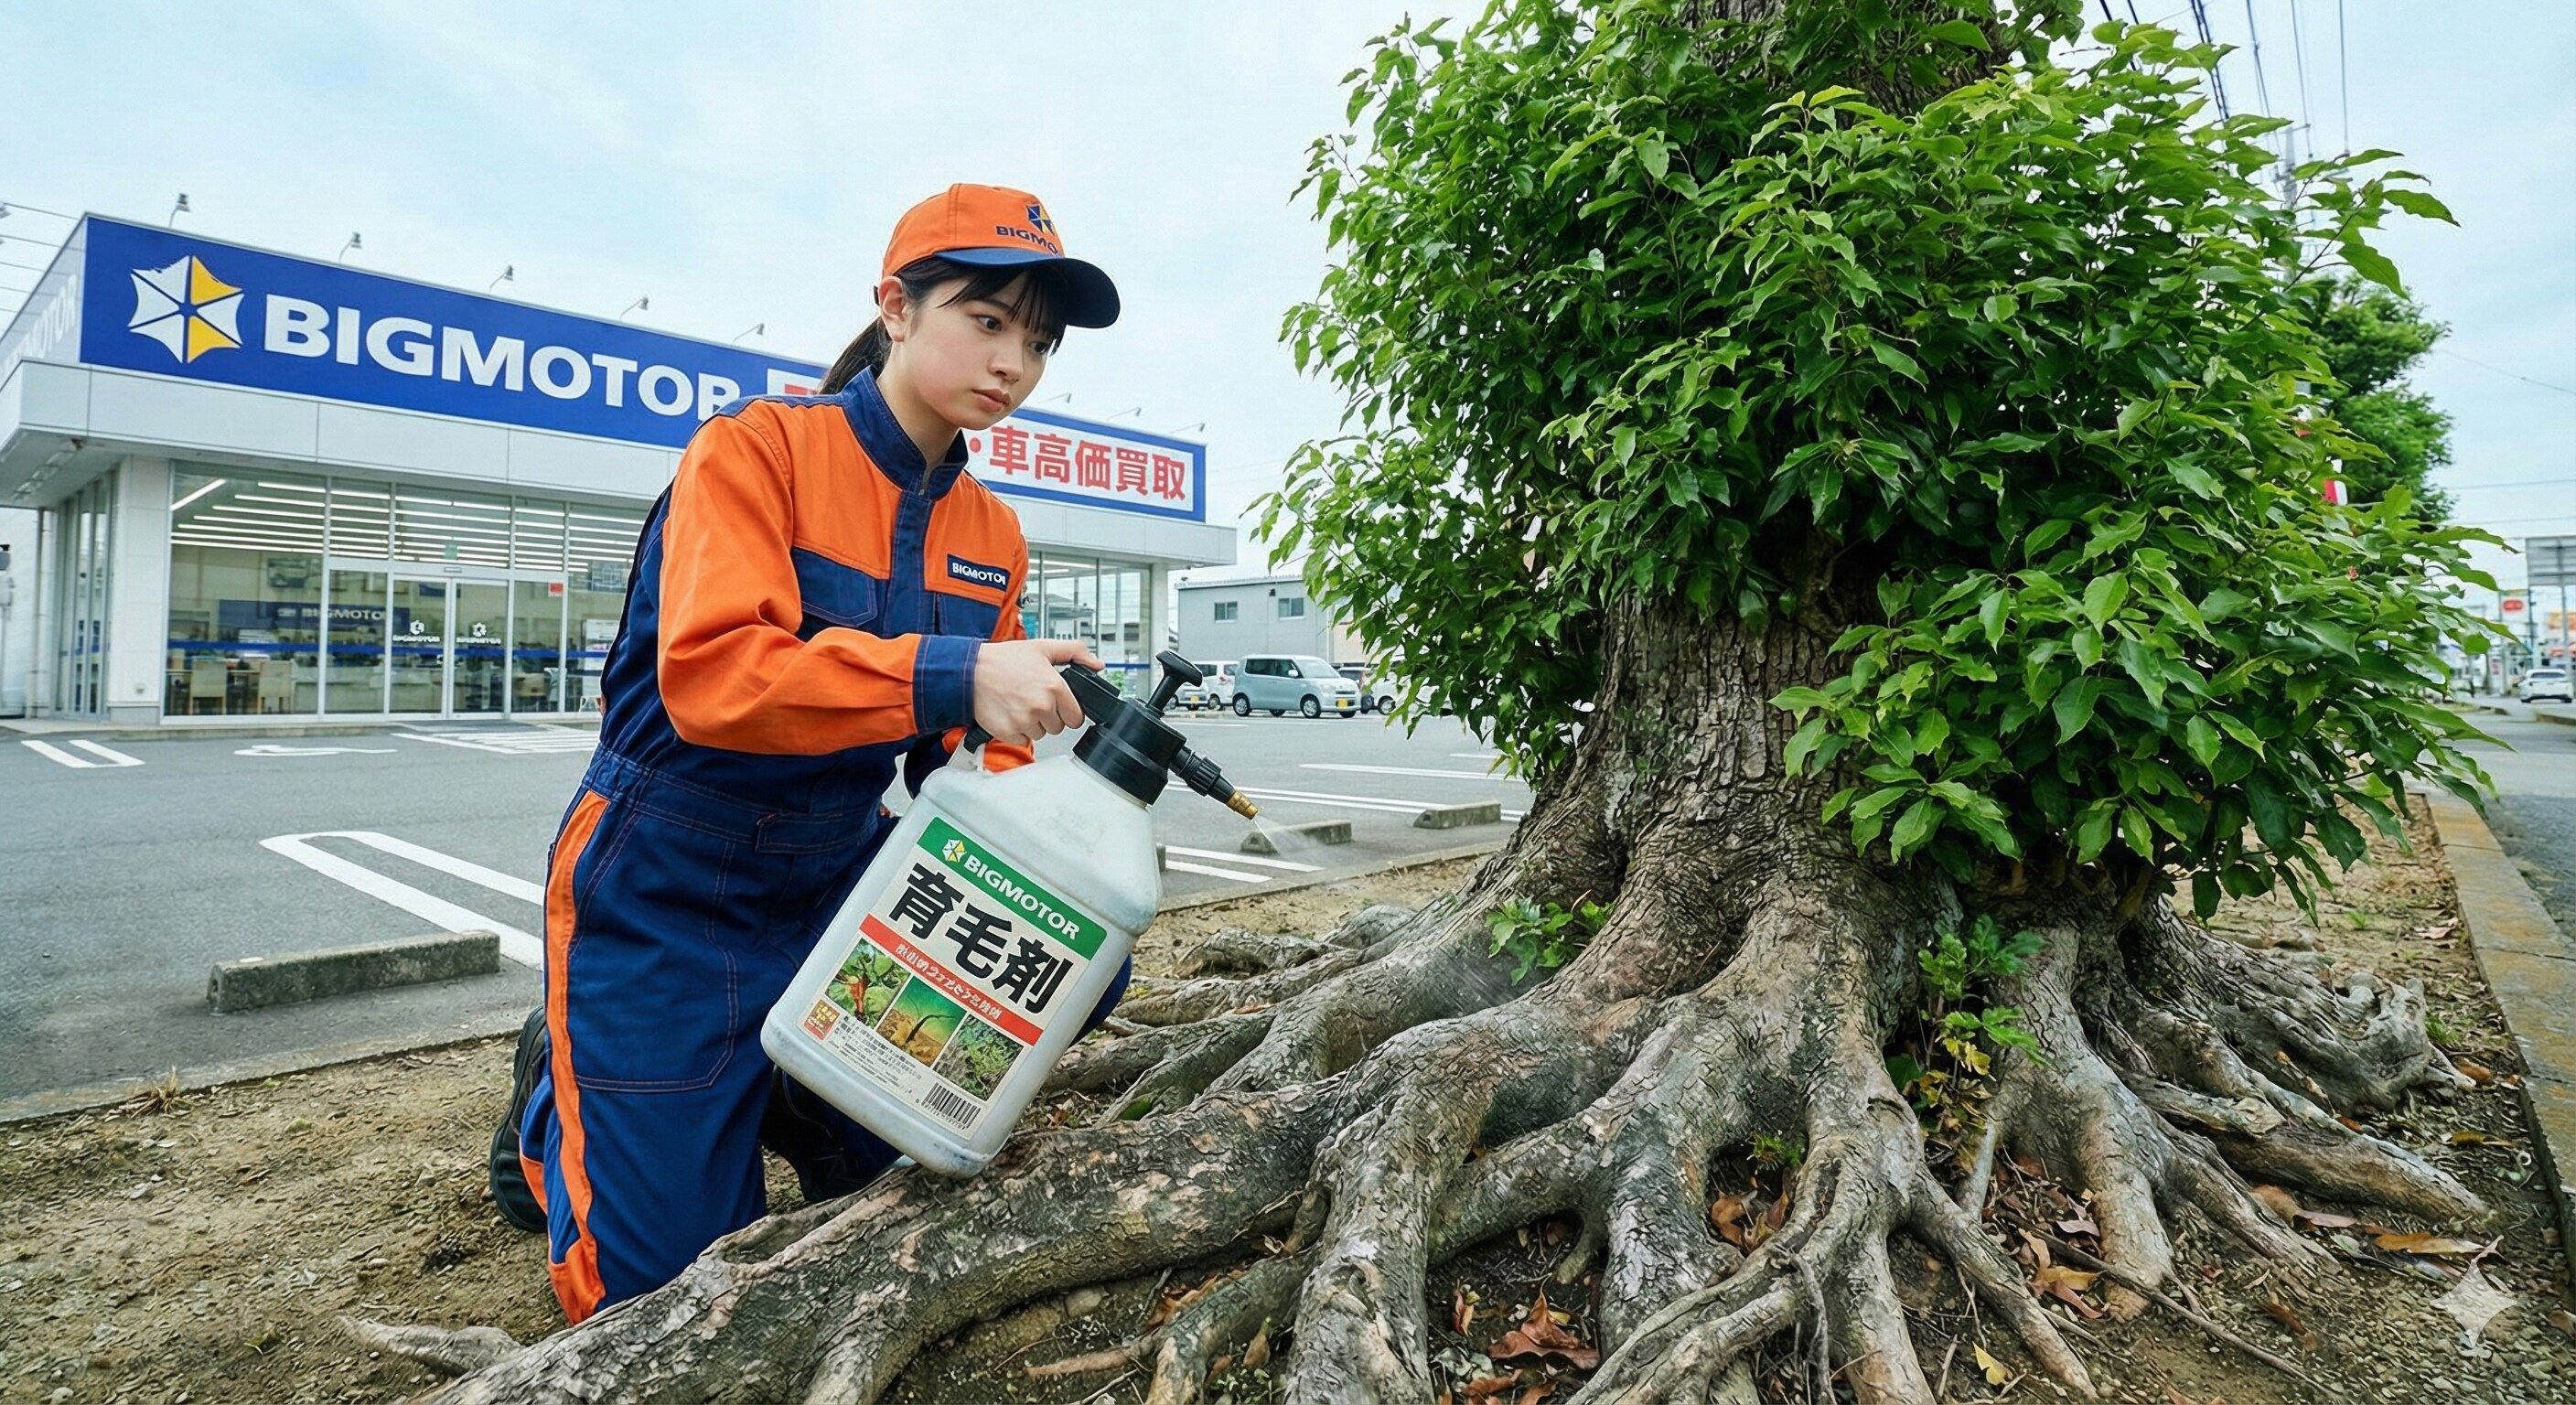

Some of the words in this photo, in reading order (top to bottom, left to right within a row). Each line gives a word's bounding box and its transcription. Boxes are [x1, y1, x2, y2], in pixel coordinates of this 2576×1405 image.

[264, 294, 741, 422] BIGMOTOR
[888, 862, 1074, 1014] 育毛剤
[963, 853, 1080, 940] BIGMOTOR
